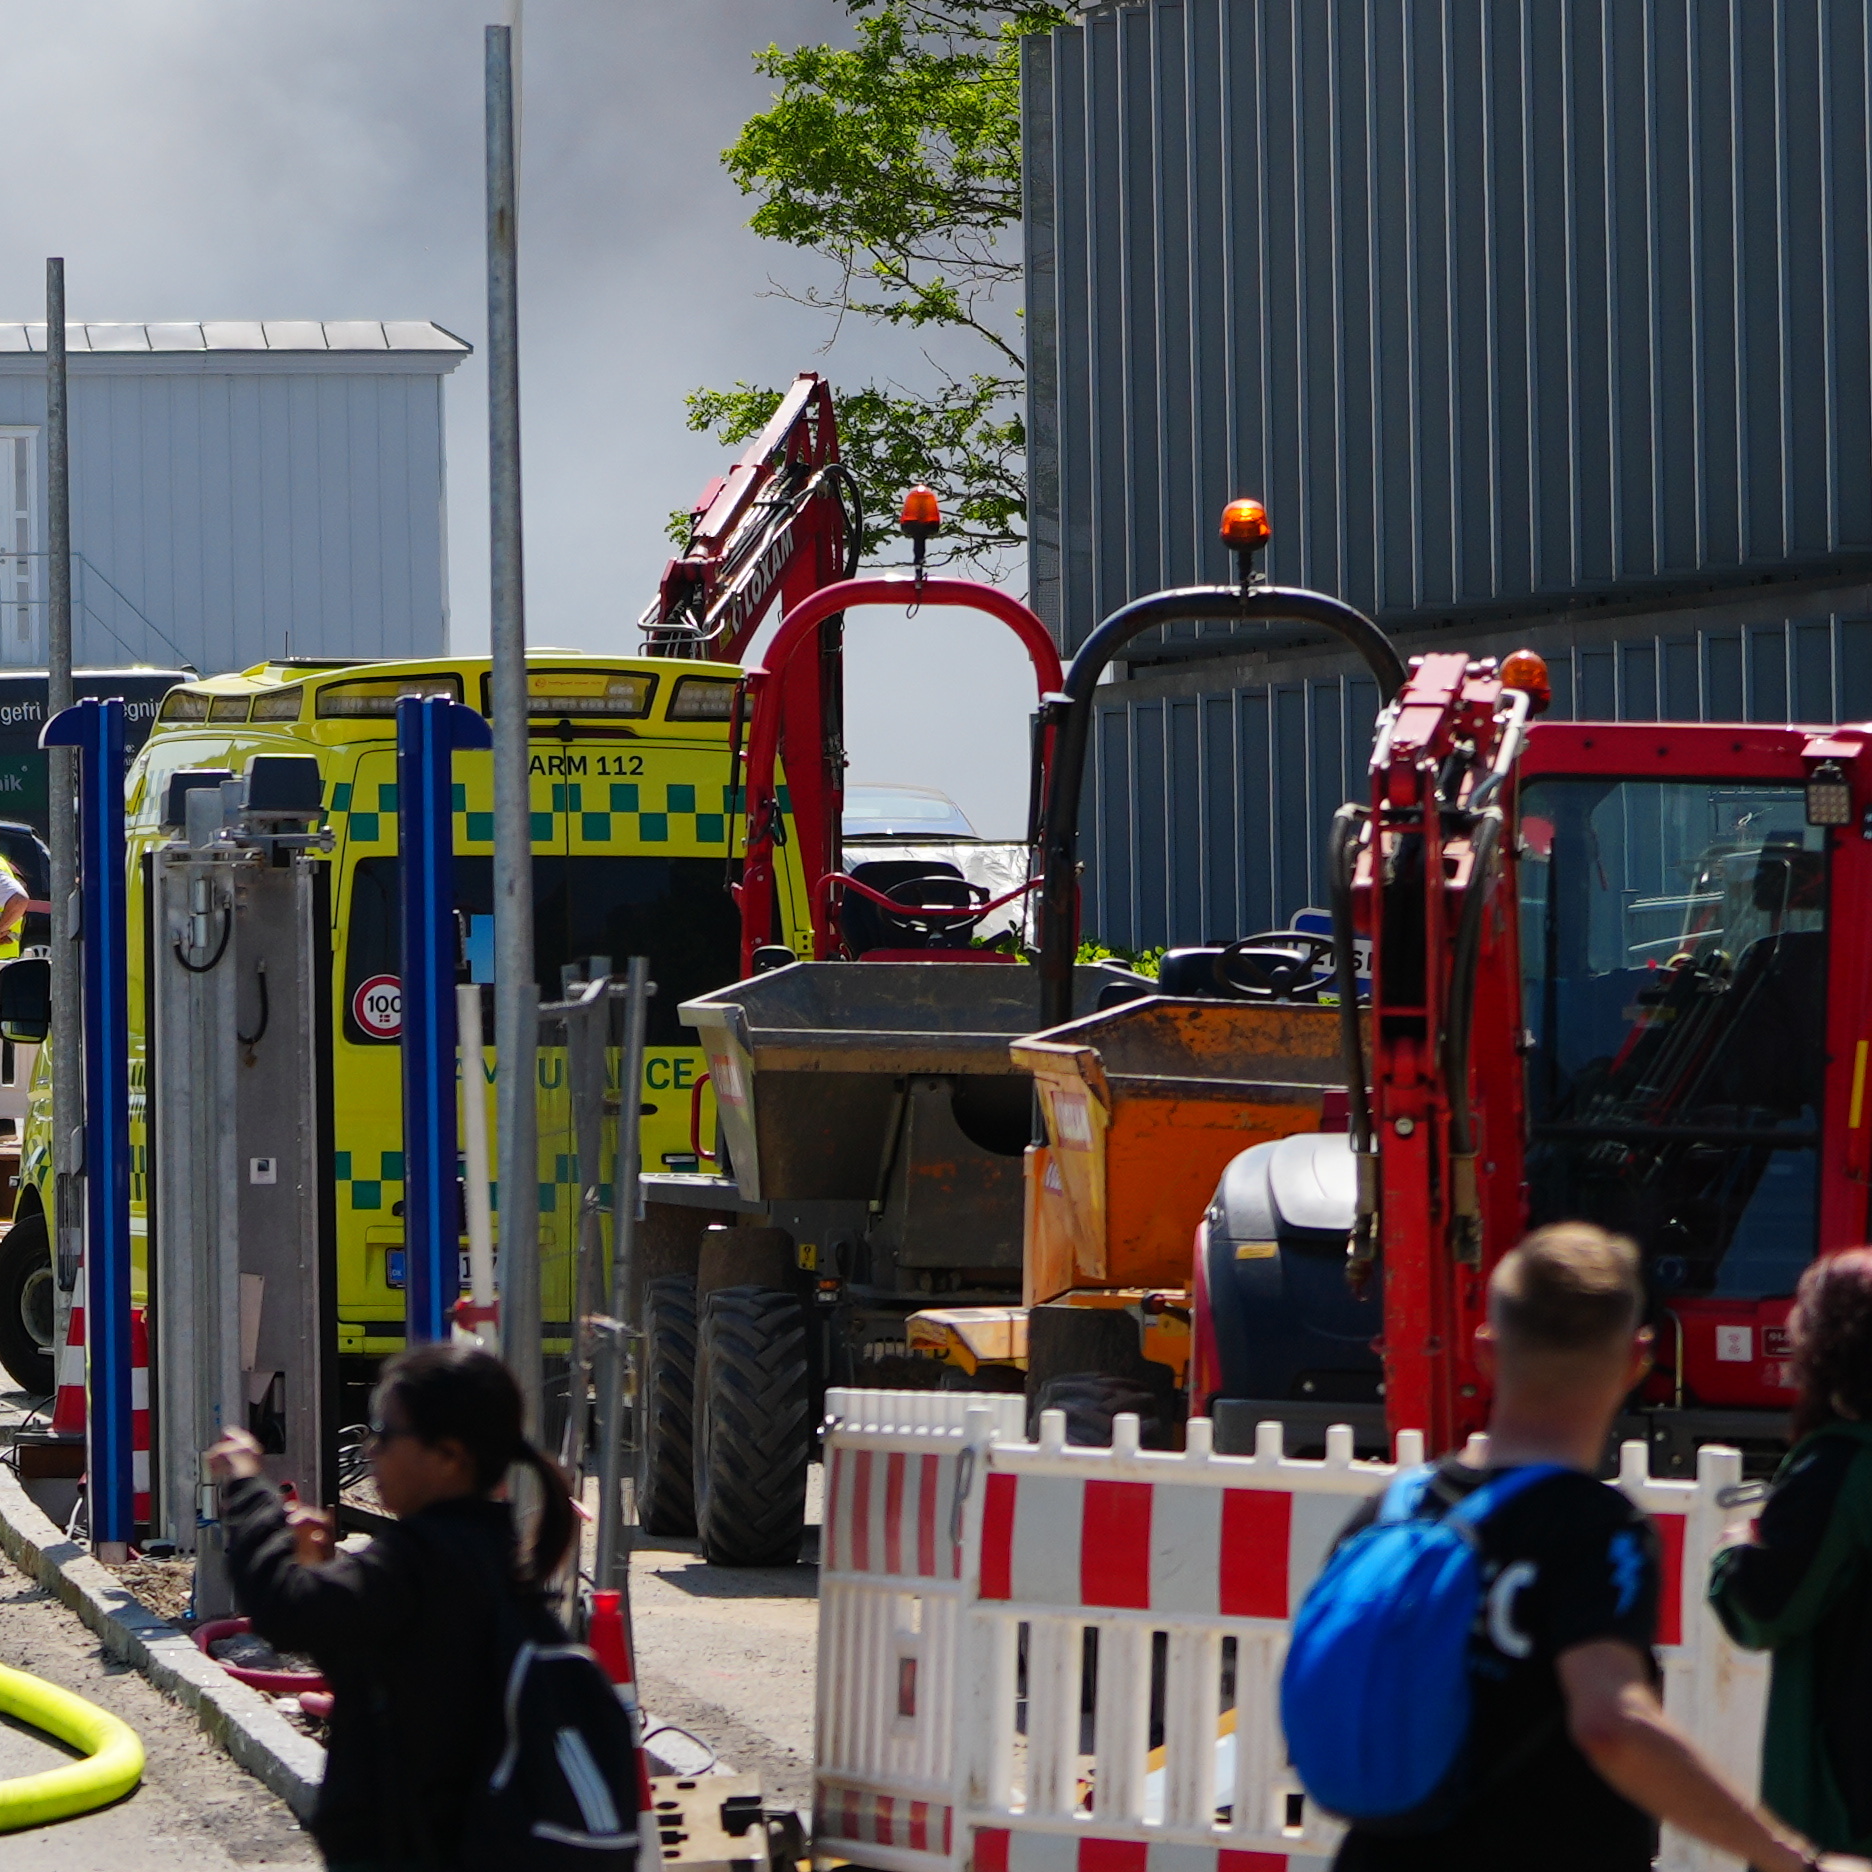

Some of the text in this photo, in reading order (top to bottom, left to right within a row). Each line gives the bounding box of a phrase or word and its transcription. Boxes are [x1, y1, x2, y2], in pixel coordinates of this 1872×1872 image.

[743, 525, 795, 619] LOXAM
[529, 755, 644, 776] ARM 112
[367, 995, 402, 1013] 100
